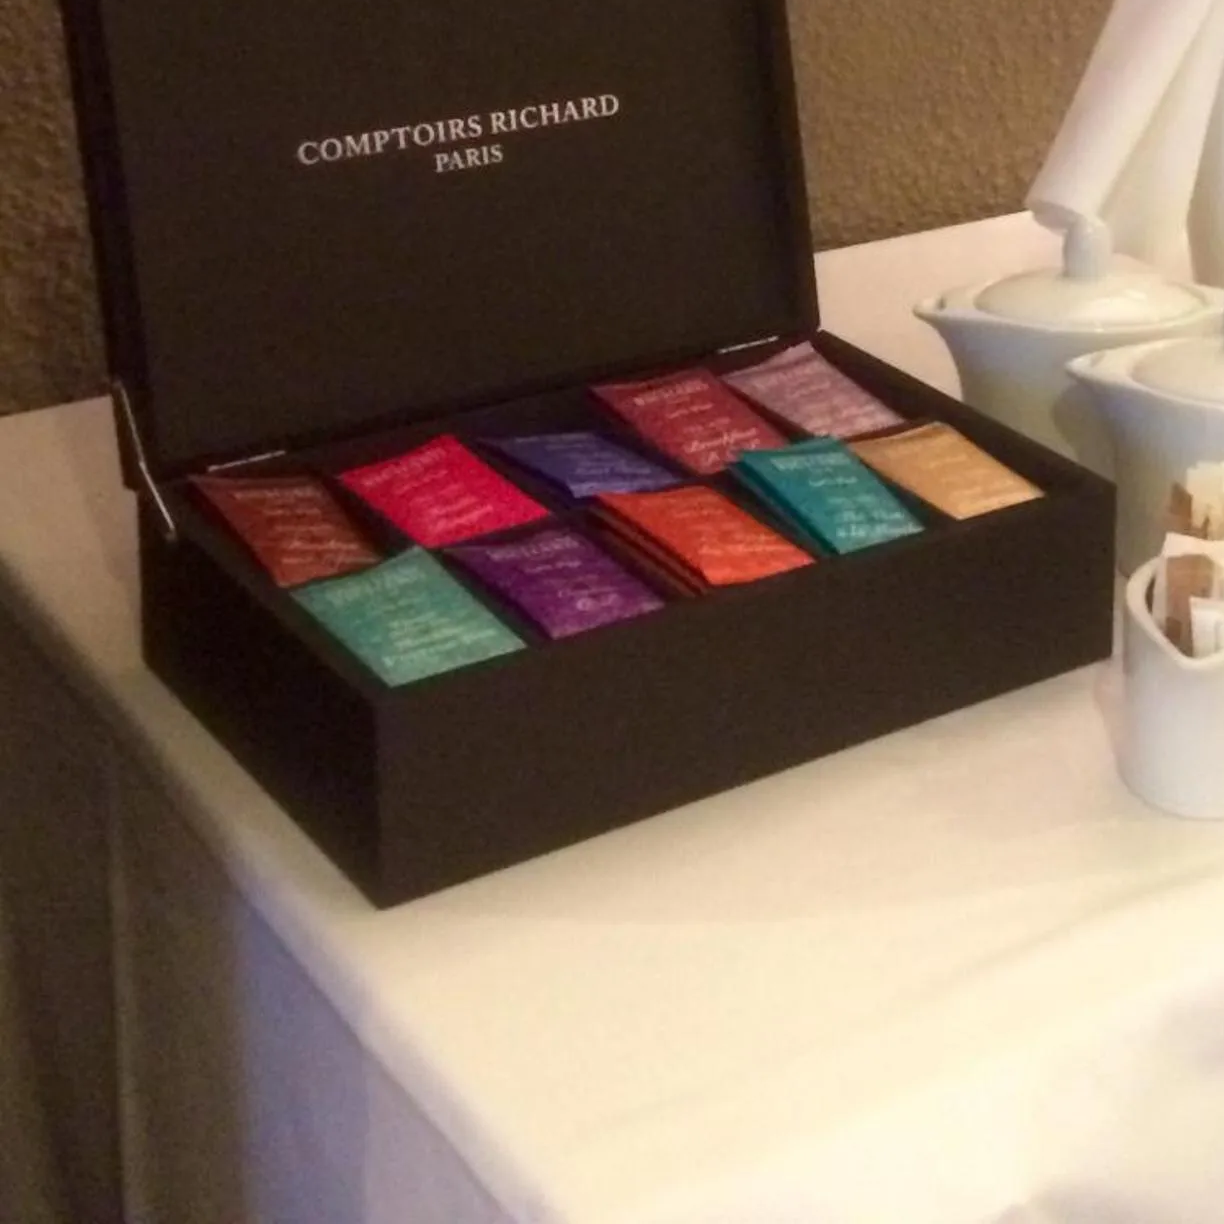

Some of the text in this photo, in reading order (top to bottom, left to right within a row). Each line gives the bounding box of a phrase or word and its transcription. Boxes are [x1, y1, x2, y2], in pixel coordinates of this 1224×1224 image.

[296, 93, 621, 166] COMPTOIRS RICHARD
[434, 143, 505, 174] PARIS
